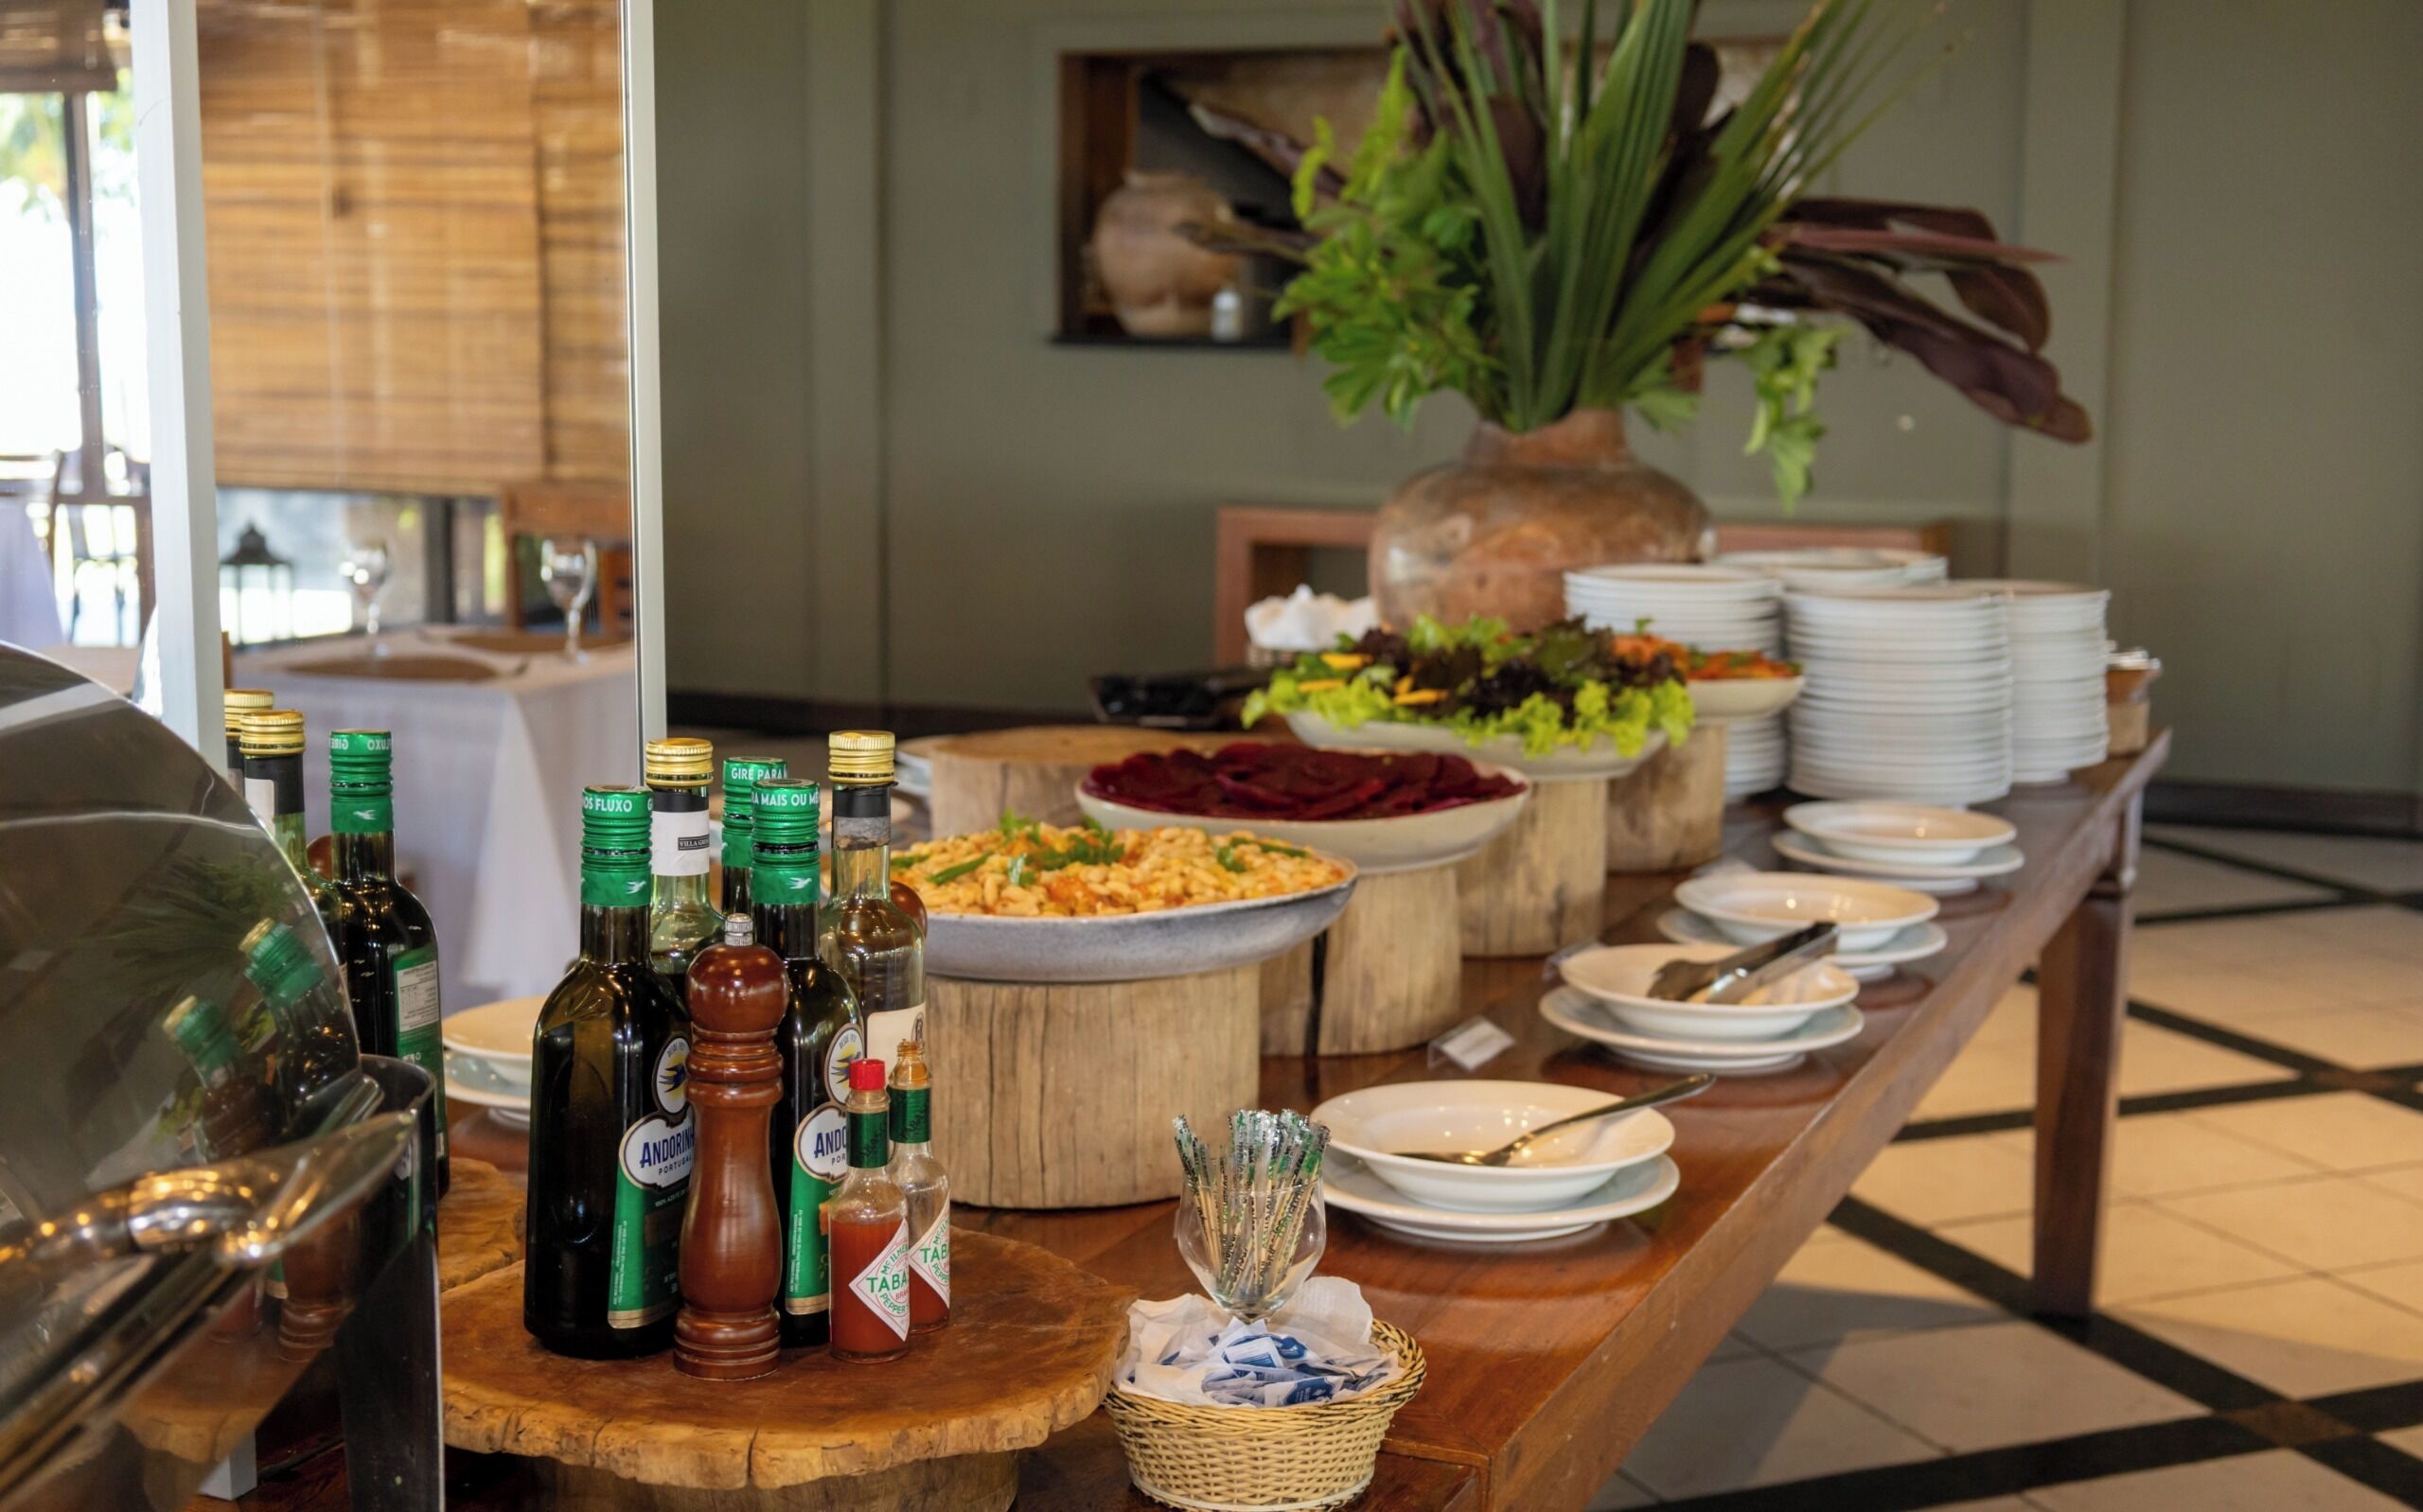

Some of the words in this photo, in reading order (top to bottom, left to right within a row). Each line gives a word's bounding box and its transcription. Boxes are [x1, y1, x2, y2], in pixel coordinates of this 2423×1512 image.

[731, 767, 754, 781] GIRE
[757, 767, 783, 781] PARA
[595, 797, 633, 813] FLUXO
[761, 793, 787, 807] MAIS
[790, 793, 807, 807] OU
[640, 1127, 696, 1169] ANDORINH
[866, 1270, 909, 1293] TABA
